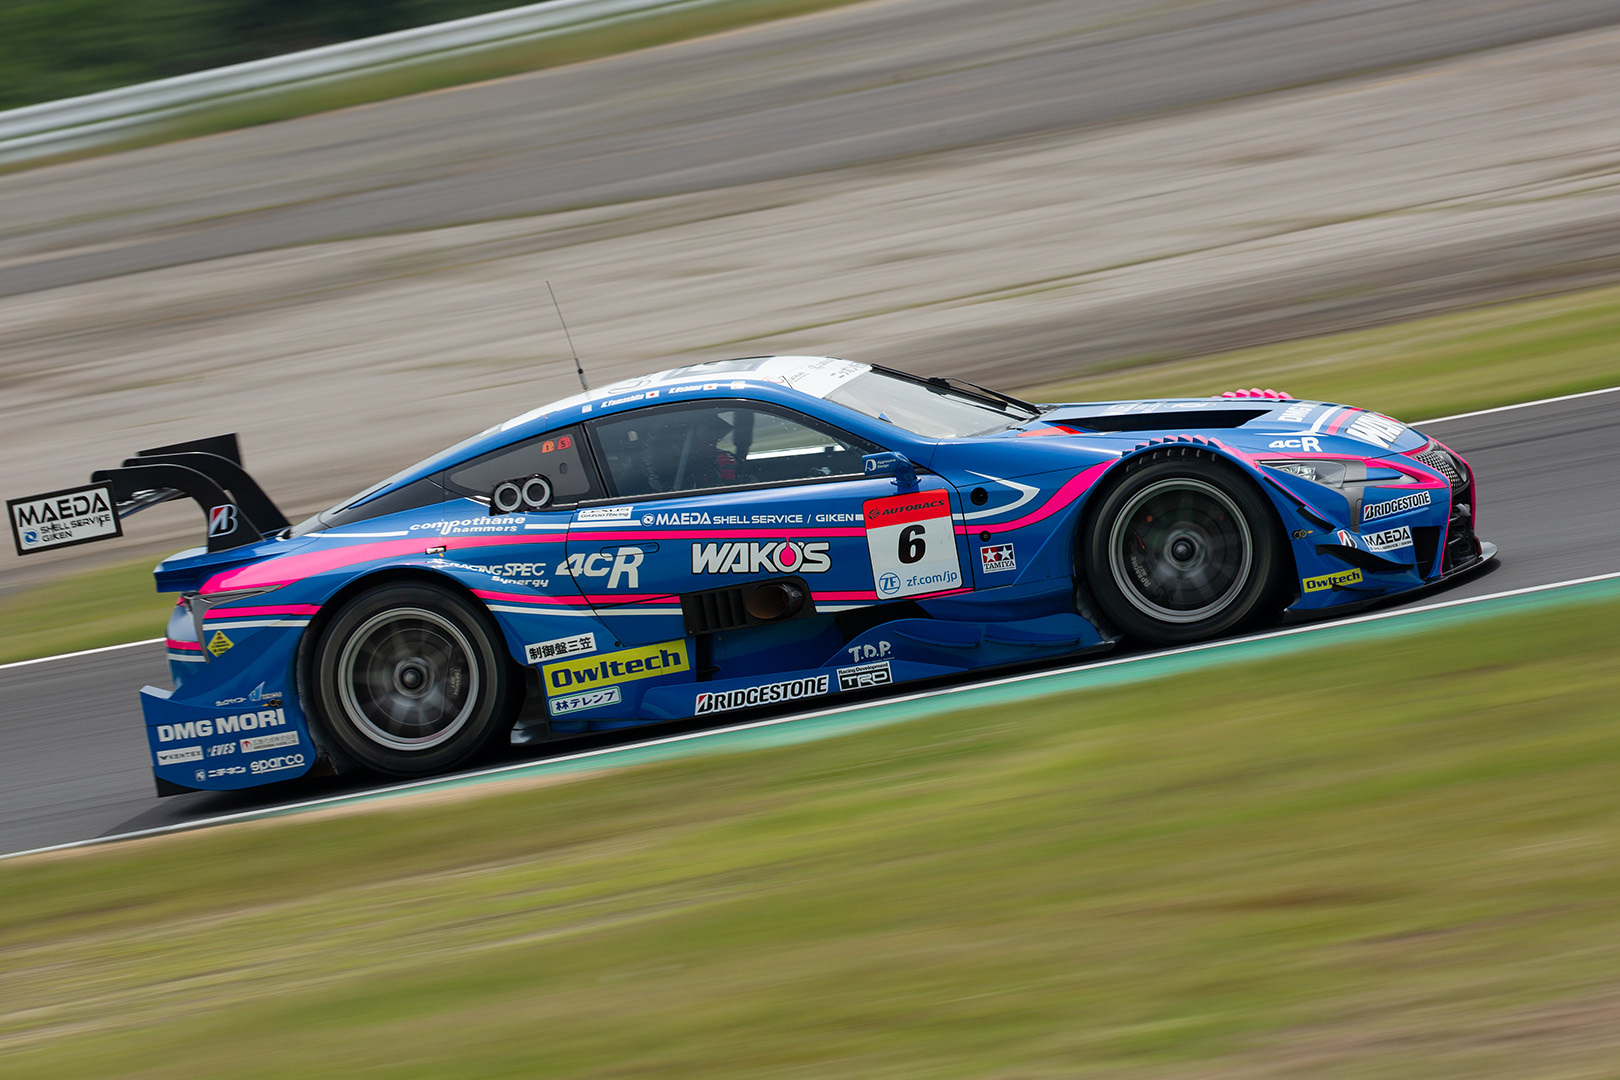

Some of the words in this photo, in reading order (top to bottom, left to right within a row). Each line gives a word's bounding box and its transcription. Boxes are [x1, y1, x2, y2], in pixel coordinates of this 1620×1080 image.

[1268, 436, 1322, 452] 4CR
[18, 492, 110, 528] MAEDA
[880, 499, 945, 516] AUTOBACS
[1363, 490, 1431, 521] BRIDGESTONE
[656, 511, 711, 526] MAEDA
[713, 514, 749, 525] SHELL
[751, 513, 803, 524] SERVICE
[815, 513, 854, 523] GIKEN
[452, 525, 517, 533] hammers
[1364, 527, 1411, 546] MAEDA
[897, 524, 926, 564] 6
[502, 563, 546, 576] SPEC
[555, 547, 645, 590] 4CR
[983, 560, 1015, 570] TAMIYA
[491, 576, 549, 587] Synergy
[906, 570, 958, 588] zf.com/jp
[1306, 571, 1360, 590] Owltech
[529, 637, 592, 660] 制御盤三笠
[550, 649, 681, 688] Owltech
[841, 670, 888, 688] TRD
[555, 690, 615, 711] 林テレンプ
[695, 675, 828, 714] BRIDGESTONE
[157, 721, 213, 742] DMG
[215, 709, 286, 735] MORI
[250, 754, 305, 772] sparco
